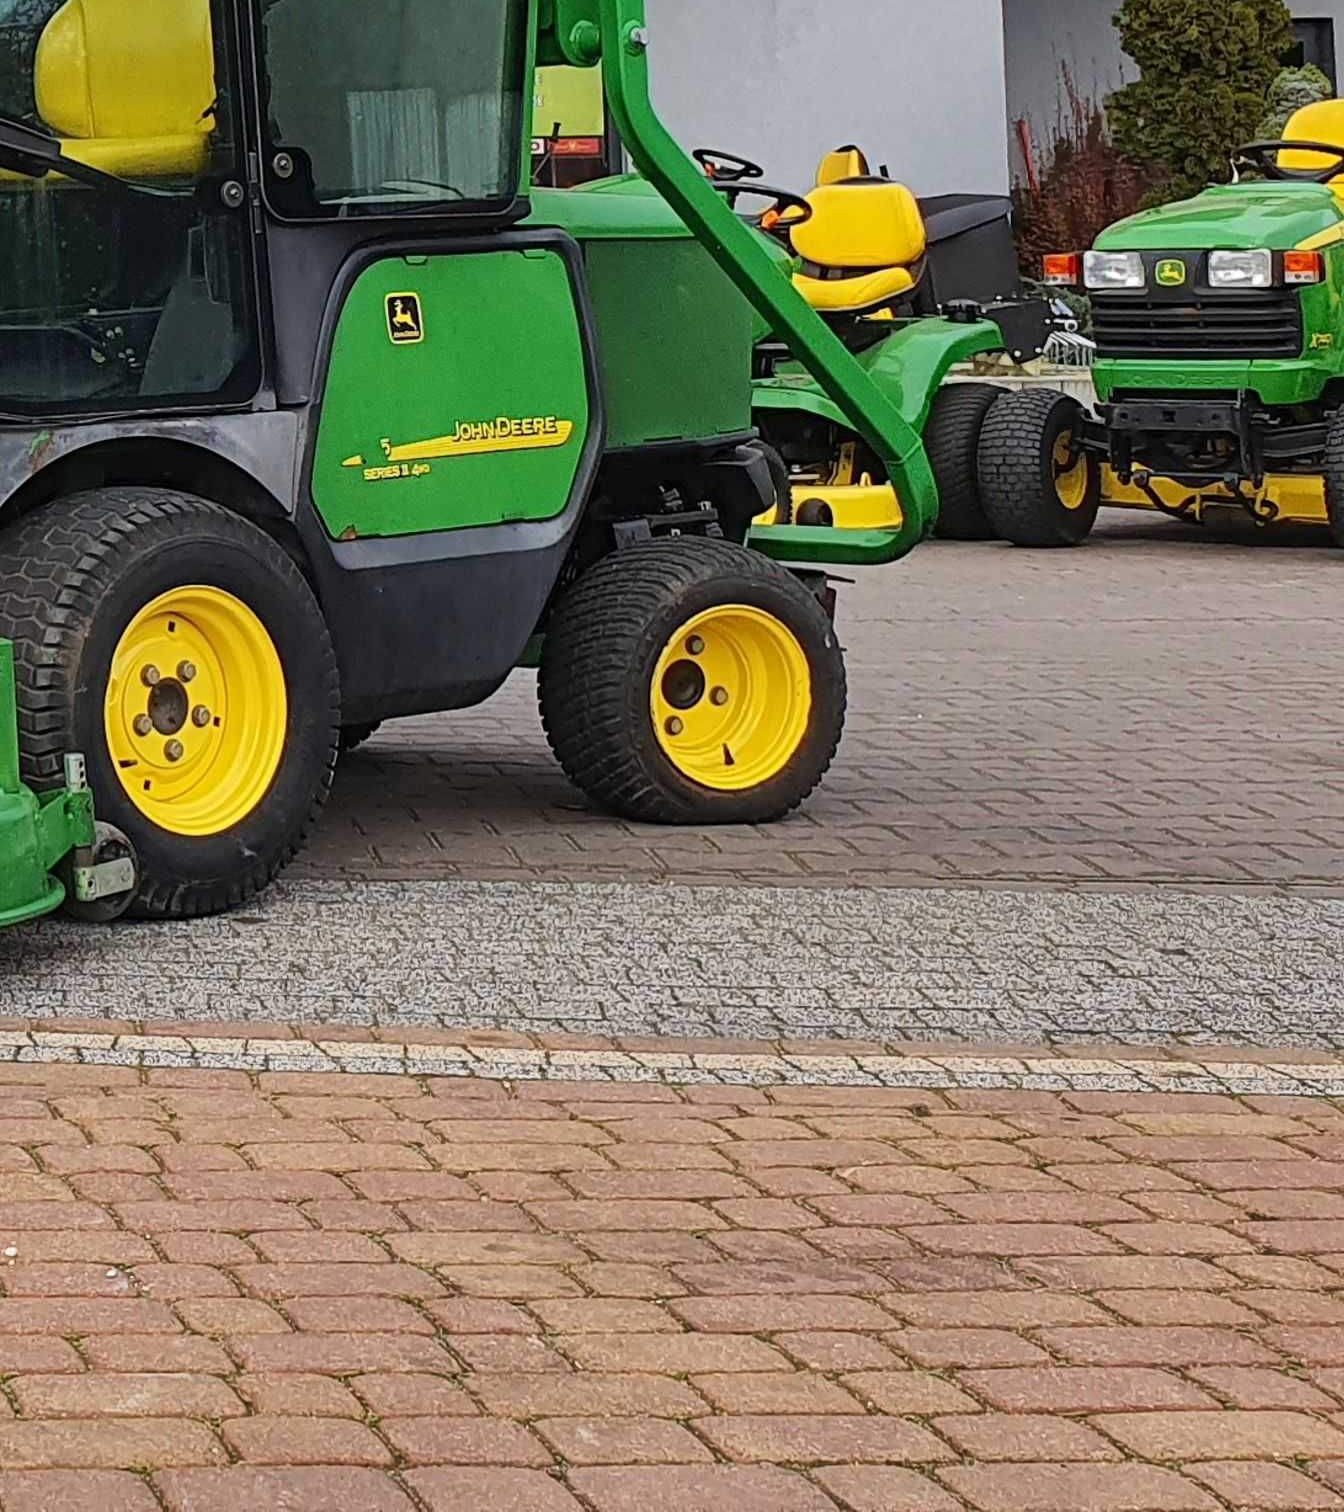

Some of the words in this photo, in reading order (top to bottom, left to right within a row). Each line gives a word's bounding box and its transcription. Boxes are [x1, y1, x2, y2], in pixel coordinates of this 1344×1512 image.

[453, 420, 495, 442] JOHN
[495, 416, 557, 437] DEERE
[363, 464, 401, 480] SERIES
